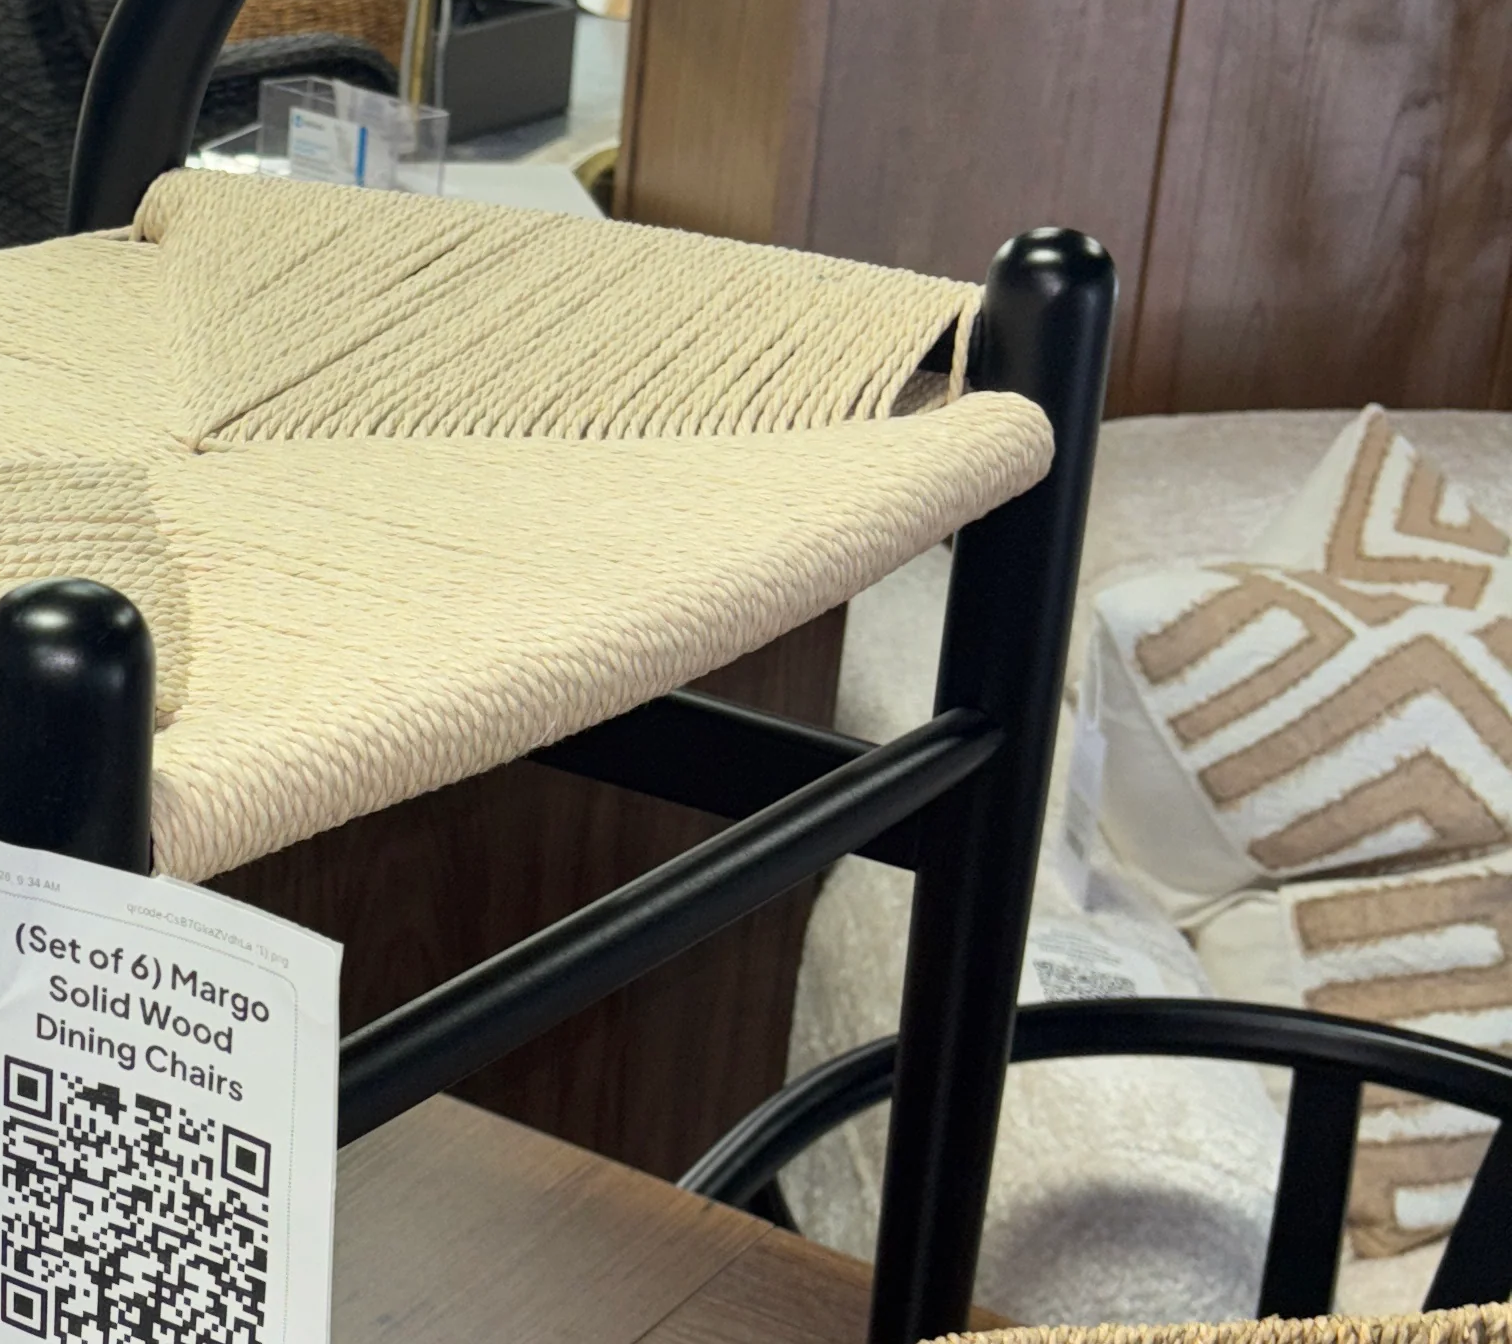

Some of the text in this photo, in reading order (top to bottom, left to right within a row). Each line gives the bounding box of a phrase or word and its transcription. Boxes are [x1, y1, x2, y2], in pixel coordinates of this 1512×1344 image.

[42, 880, 61, 892] AM
[15, 922, 270, 1022] (Set of 6) Margo
[37, 1012, 244, 1101] Dining Chairs
[49, 975, 233, 1054] Solid Wood
